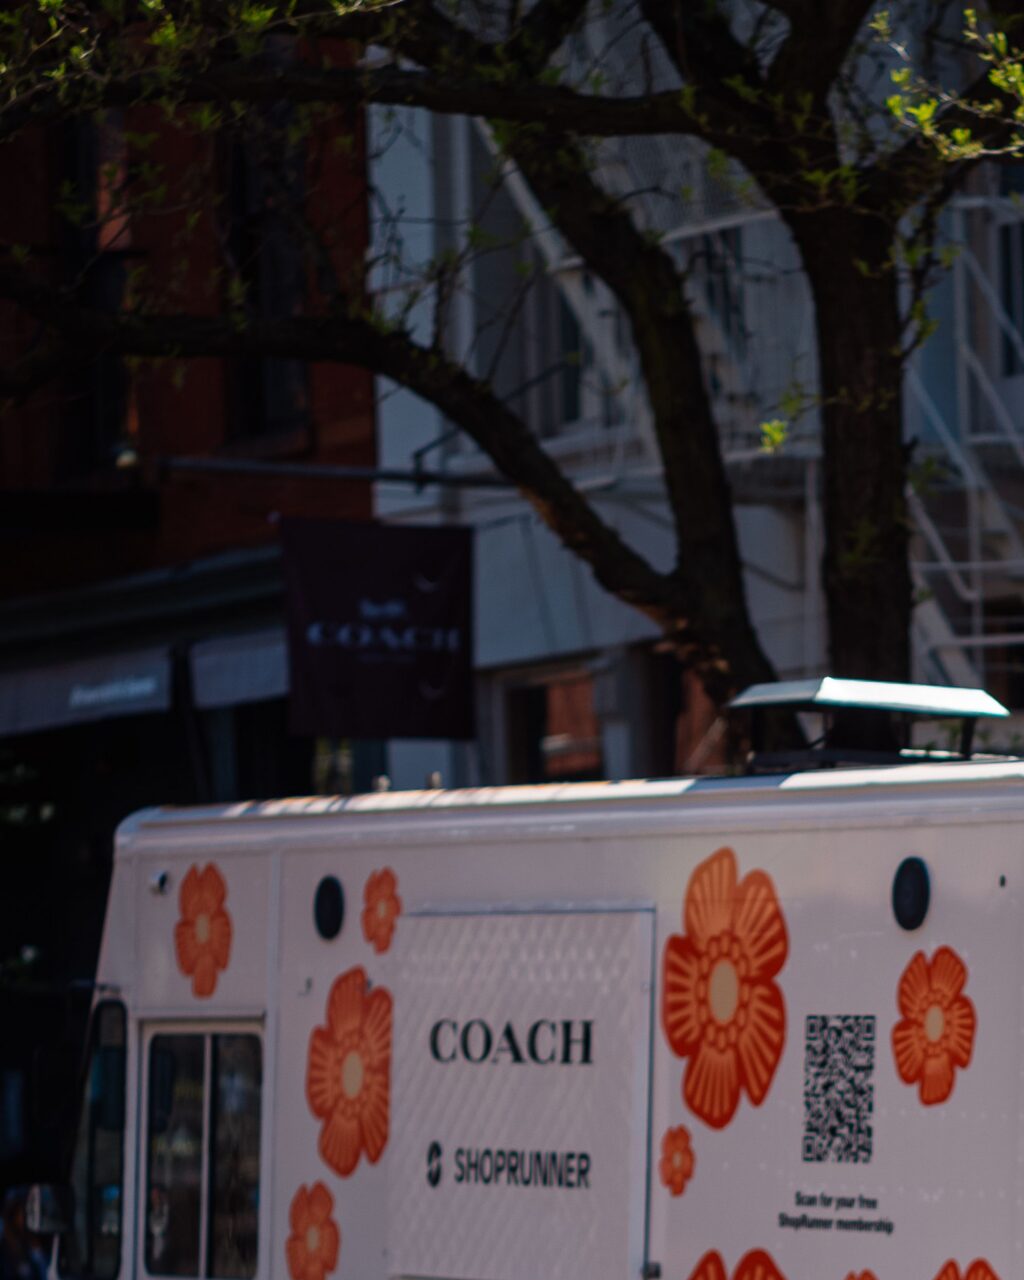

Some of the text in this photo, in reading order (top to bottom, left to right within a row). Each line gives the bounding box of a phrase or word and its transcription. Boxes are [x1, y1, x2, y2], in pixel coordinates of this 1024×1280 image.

[429, 1018, 594, 1065] COACH
[454, 1147, 592, 1189] SHOPRUNNER
[795, 1191, 878, 1211] Scan for your free
[778, 1213, 894, 1235] ShopRunner membership
